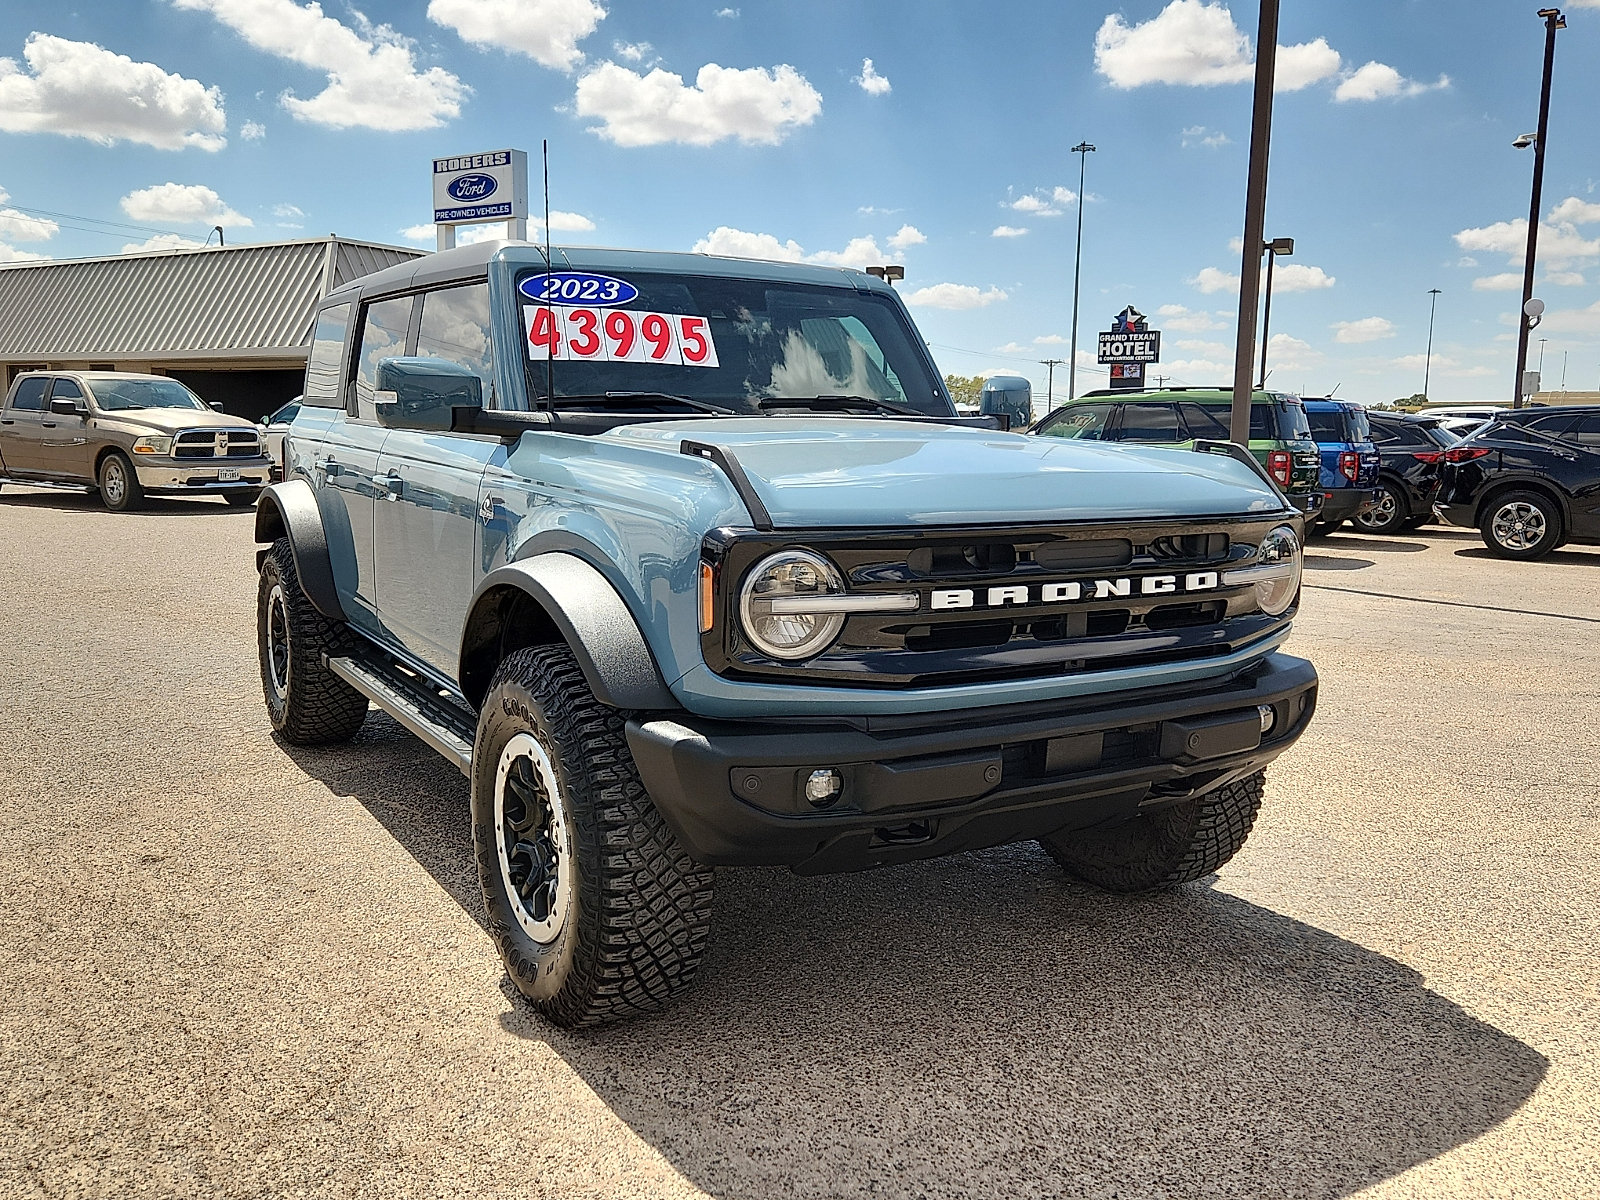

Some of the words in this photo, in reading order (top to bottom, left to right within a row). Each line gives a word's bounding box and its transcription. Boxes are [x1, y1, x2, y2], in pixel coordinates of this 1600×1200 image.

[436, 152, 507, 172] ROGERS
[456, 177, 487, 197] Ford
[436, 208, 476, 220] PRE-OWNED
[476, 204, 510, 216] VEHICLES
[539, 278, 621, 300] 2023
[529, 307, 709, 363] 43995
[1099, 341, 1154, 356] HOTEL
[930, 571, 1218, 609] BRONCO
